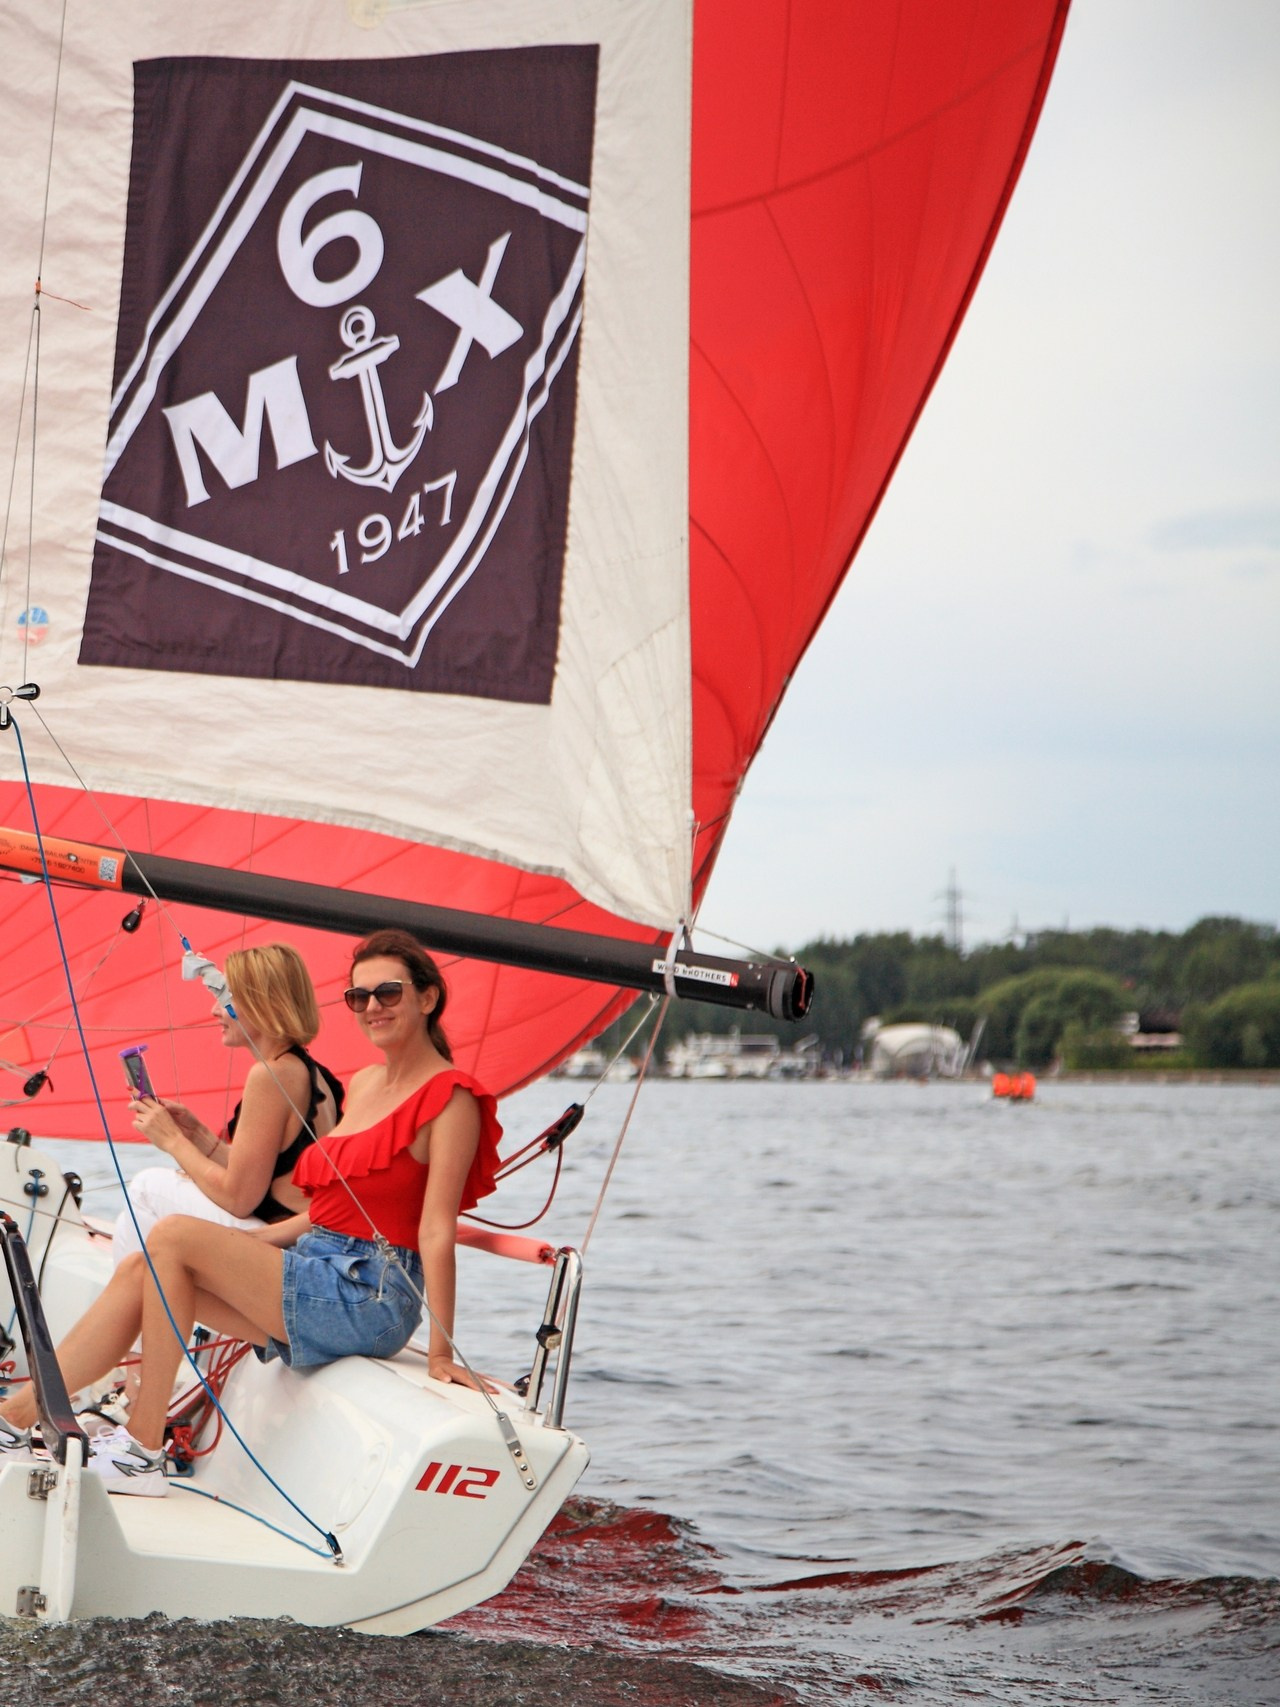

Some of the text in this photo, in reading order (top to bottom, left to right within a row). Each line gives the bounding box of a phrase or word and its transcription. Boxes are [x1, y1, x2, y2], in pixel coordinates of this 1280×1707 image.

[276, 160, 385, 308] 6
[329, 470, 460, 575] 1947
[657, 963, 679, 974] WD
[415, 1461, 501, 1500] 112
